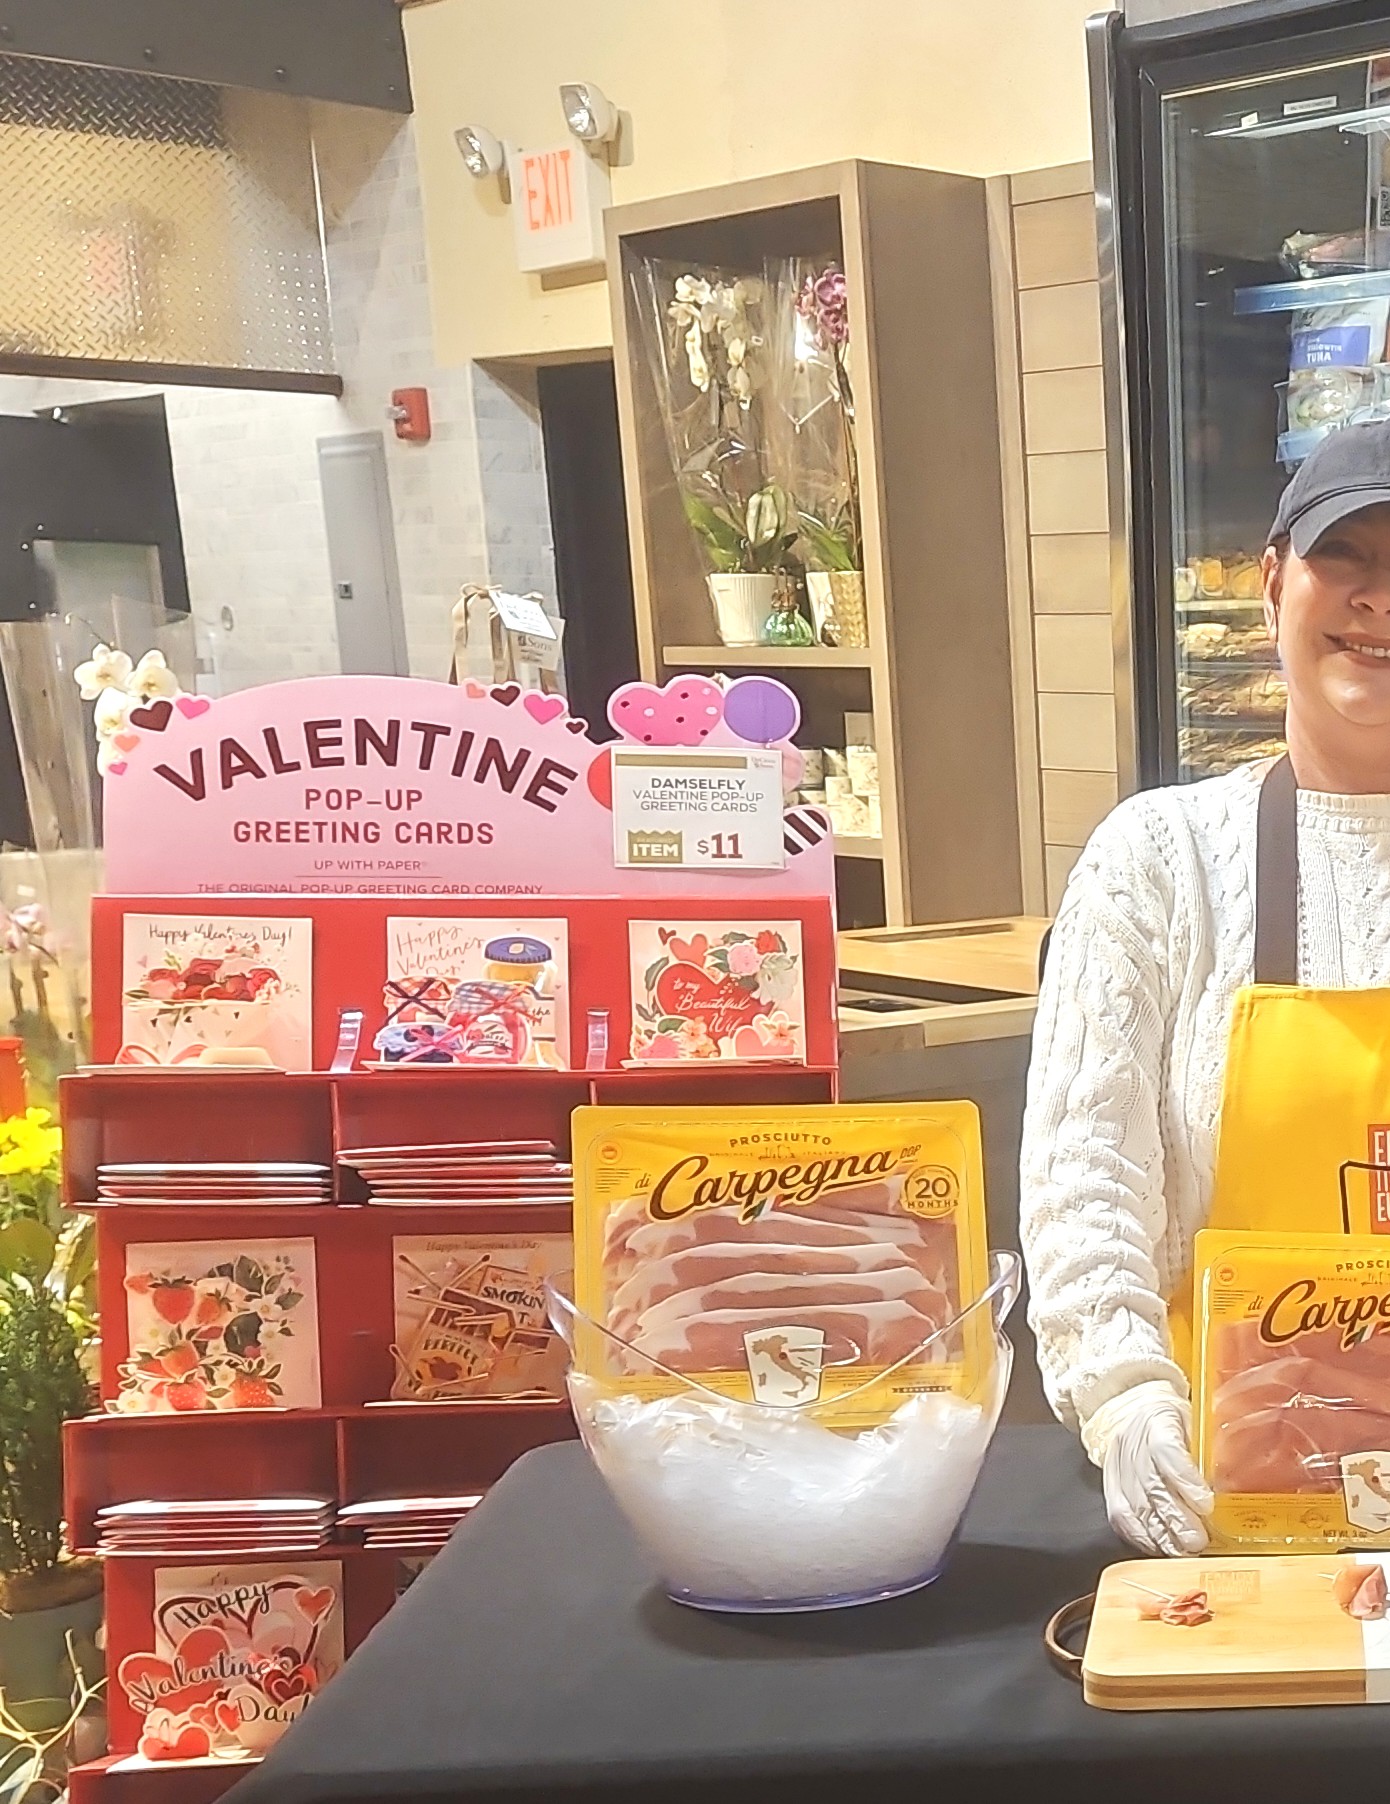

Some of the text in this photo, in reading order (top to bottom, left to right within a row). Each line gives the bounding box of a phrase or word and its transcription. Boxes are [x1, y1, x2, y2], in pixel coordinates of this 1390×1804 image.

[524, 150, 572, 230] EXIT
[1307, 353, 1331, 363] TUNA
[154, 718, 578, 813] VALENTINE
[651, 778, 746, 790] DAMSELFLY
[305, 789, 423, 811] POP-UP
[633, 790, 764, 802] VALENTINE POP-UP
[640, 801, 757, 812] GREETING CARDS
[233, 821, 495, 845] GREETING CARDS
[633, 844, 679, 857] ITEM
[697, 833, 743, 859] $11
[314, 860, 333, 871] UP
[337, 860, 373, 871] WITH
[198, 884, 543, 895] THE ORIGINAL POP-UP GREETING CARD COMPANY
[149, 923, 189, 945] Happy
[397, 925, 463, 956] Happy
[673, 977, 700, 993] to my
[676, 992, 752, 1016] Beautiful
[729, 1132, 832, 1148] PROSCIUTTO
[635, 1175, 651, 1191] di
[648, 1147, 899, 1225] Carpegna
[915, 1177, 950, 1198] 20
[907, 1199, 959, 1209] MONTHS
[1248, 1295, 1265, 1311] di
[172, 1582, 271, 1630] Happy
